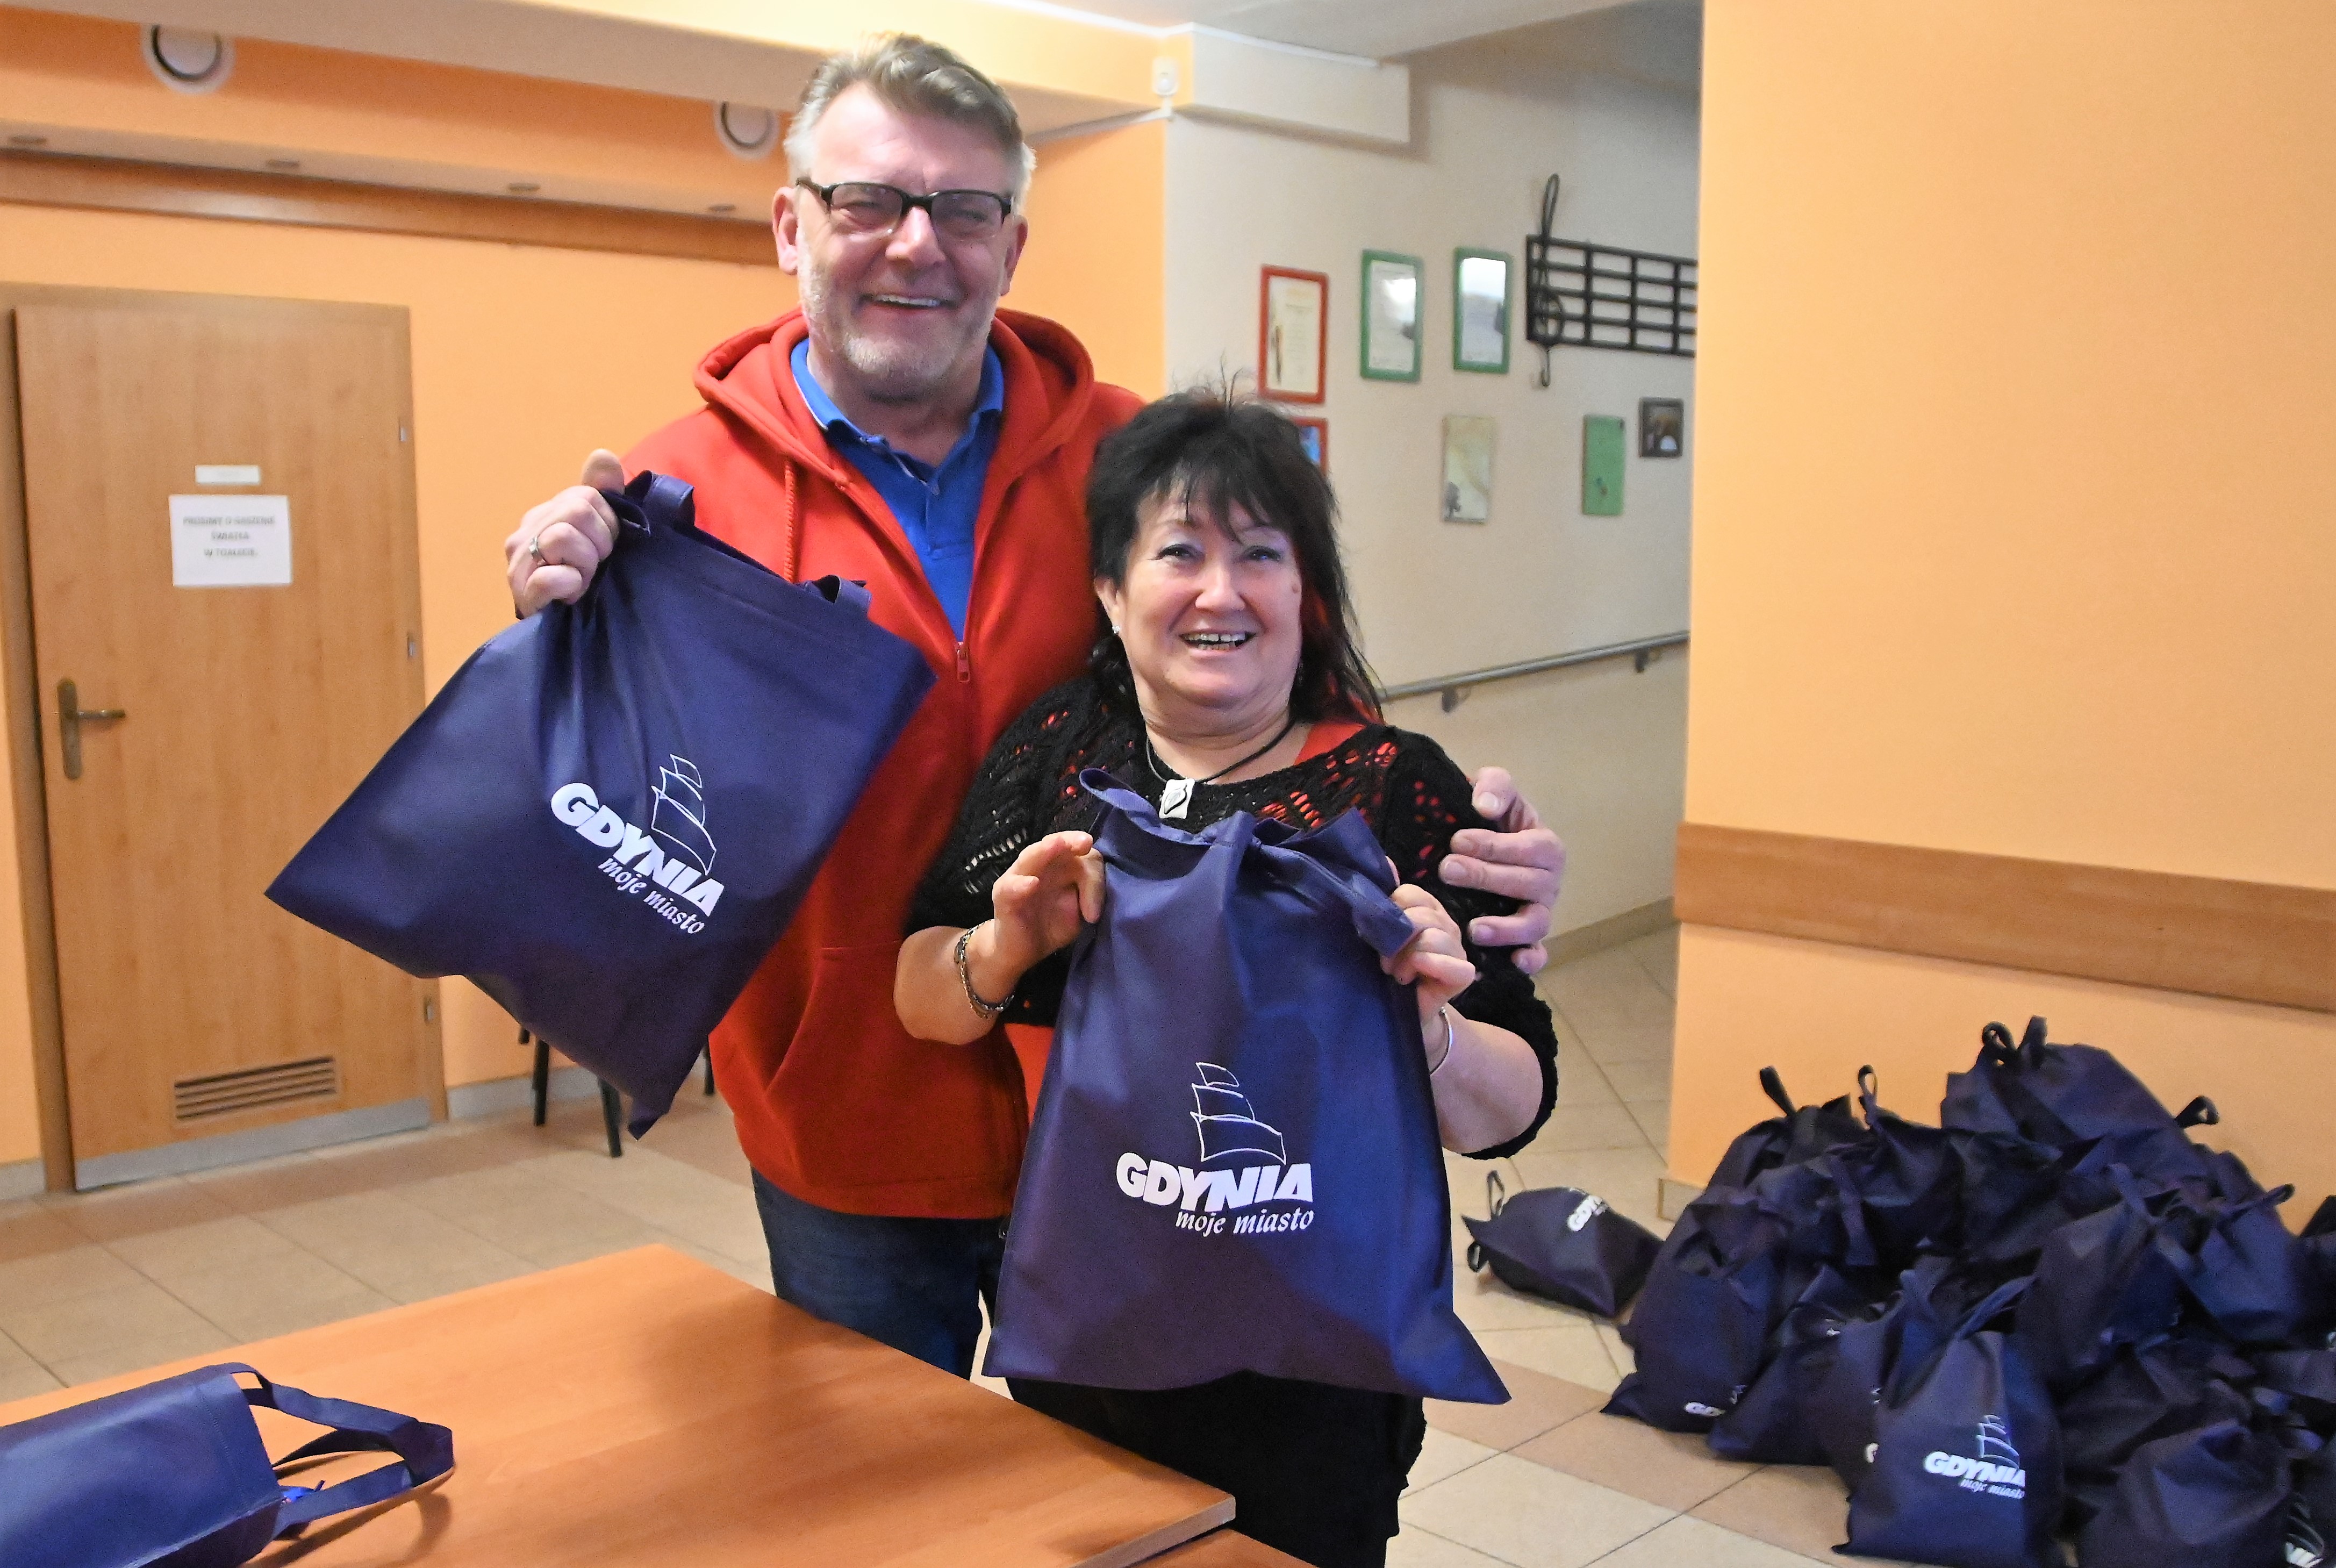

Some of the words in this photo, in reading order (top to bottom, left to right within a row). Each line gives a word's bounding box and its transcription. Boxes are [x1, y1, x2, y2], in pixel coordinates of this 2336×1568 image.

[551, 783, 725, 917] GDYNIA
[598, 858, 647, 894] moje
[643, 890, 705, 934] miasto
[1116, 1152, 1313, 1212] GDYNIA
[1176, 1211, 1226, 1237] moje
[1233, 1207, 1315, 1234] miasto
[1924, 1451, 2026, 1488] GDYNIA
[1960, 1478, 1988, 1493] moje
